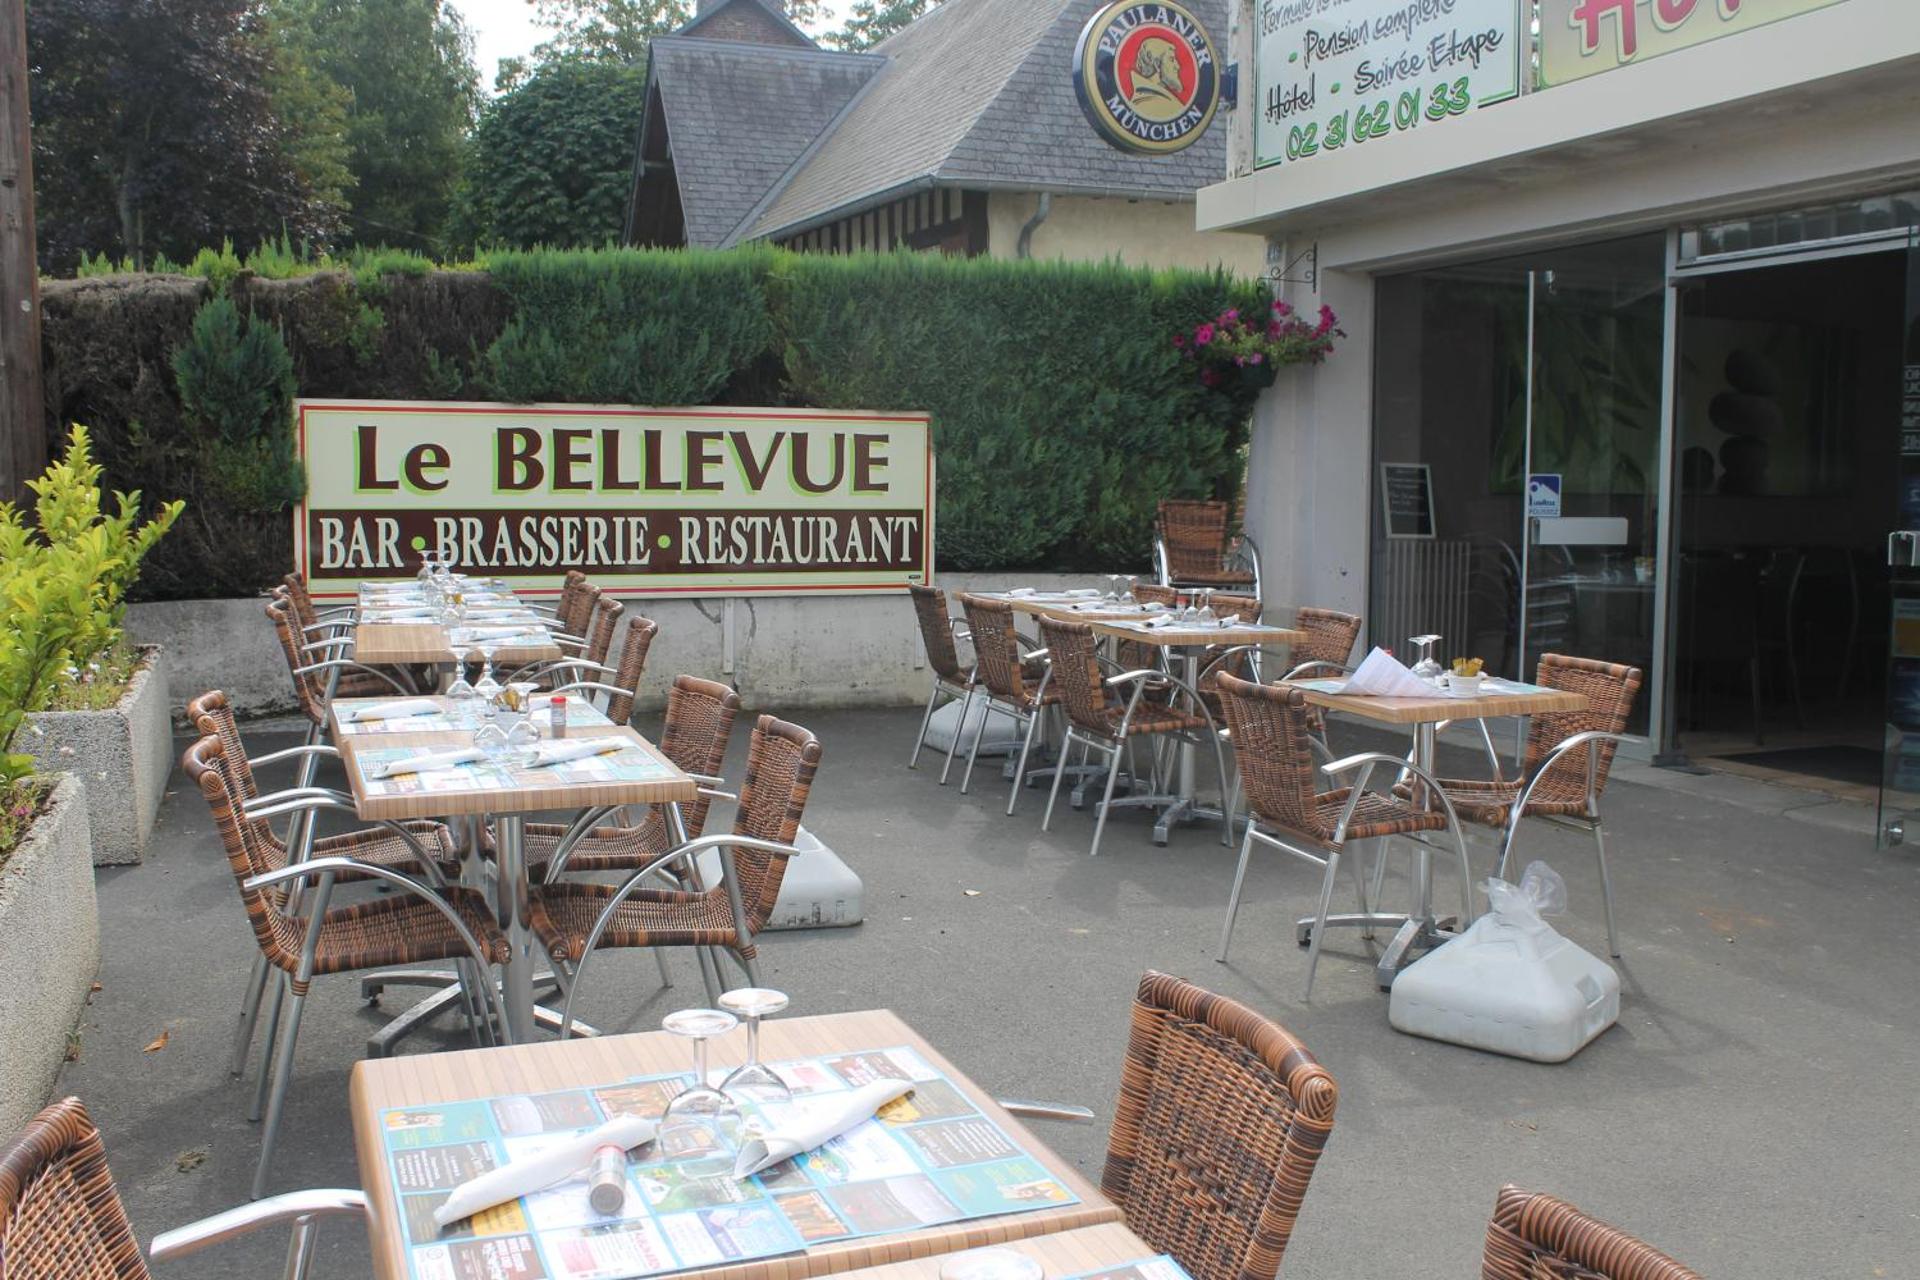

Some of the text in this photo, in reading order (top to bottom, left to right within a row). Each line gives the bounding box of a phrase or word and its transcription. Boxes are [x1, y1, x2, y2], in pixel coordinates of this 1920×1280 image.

[1099, 6, 1212, 68] PAULANER
[1304, 20, 1368, 66] Pension
[1266, 28, 1504, 121] Hôtel Soirée Etape
[1105, 95, 1203, 142] MÜNCHEN
[1288, 76, 1469, 160] 02 31 62 01 33
[354, 425, 890, 495] Le BELLEVUE
[319, 515, 917, 570] BAR BRASSERIE RESTAURANT
